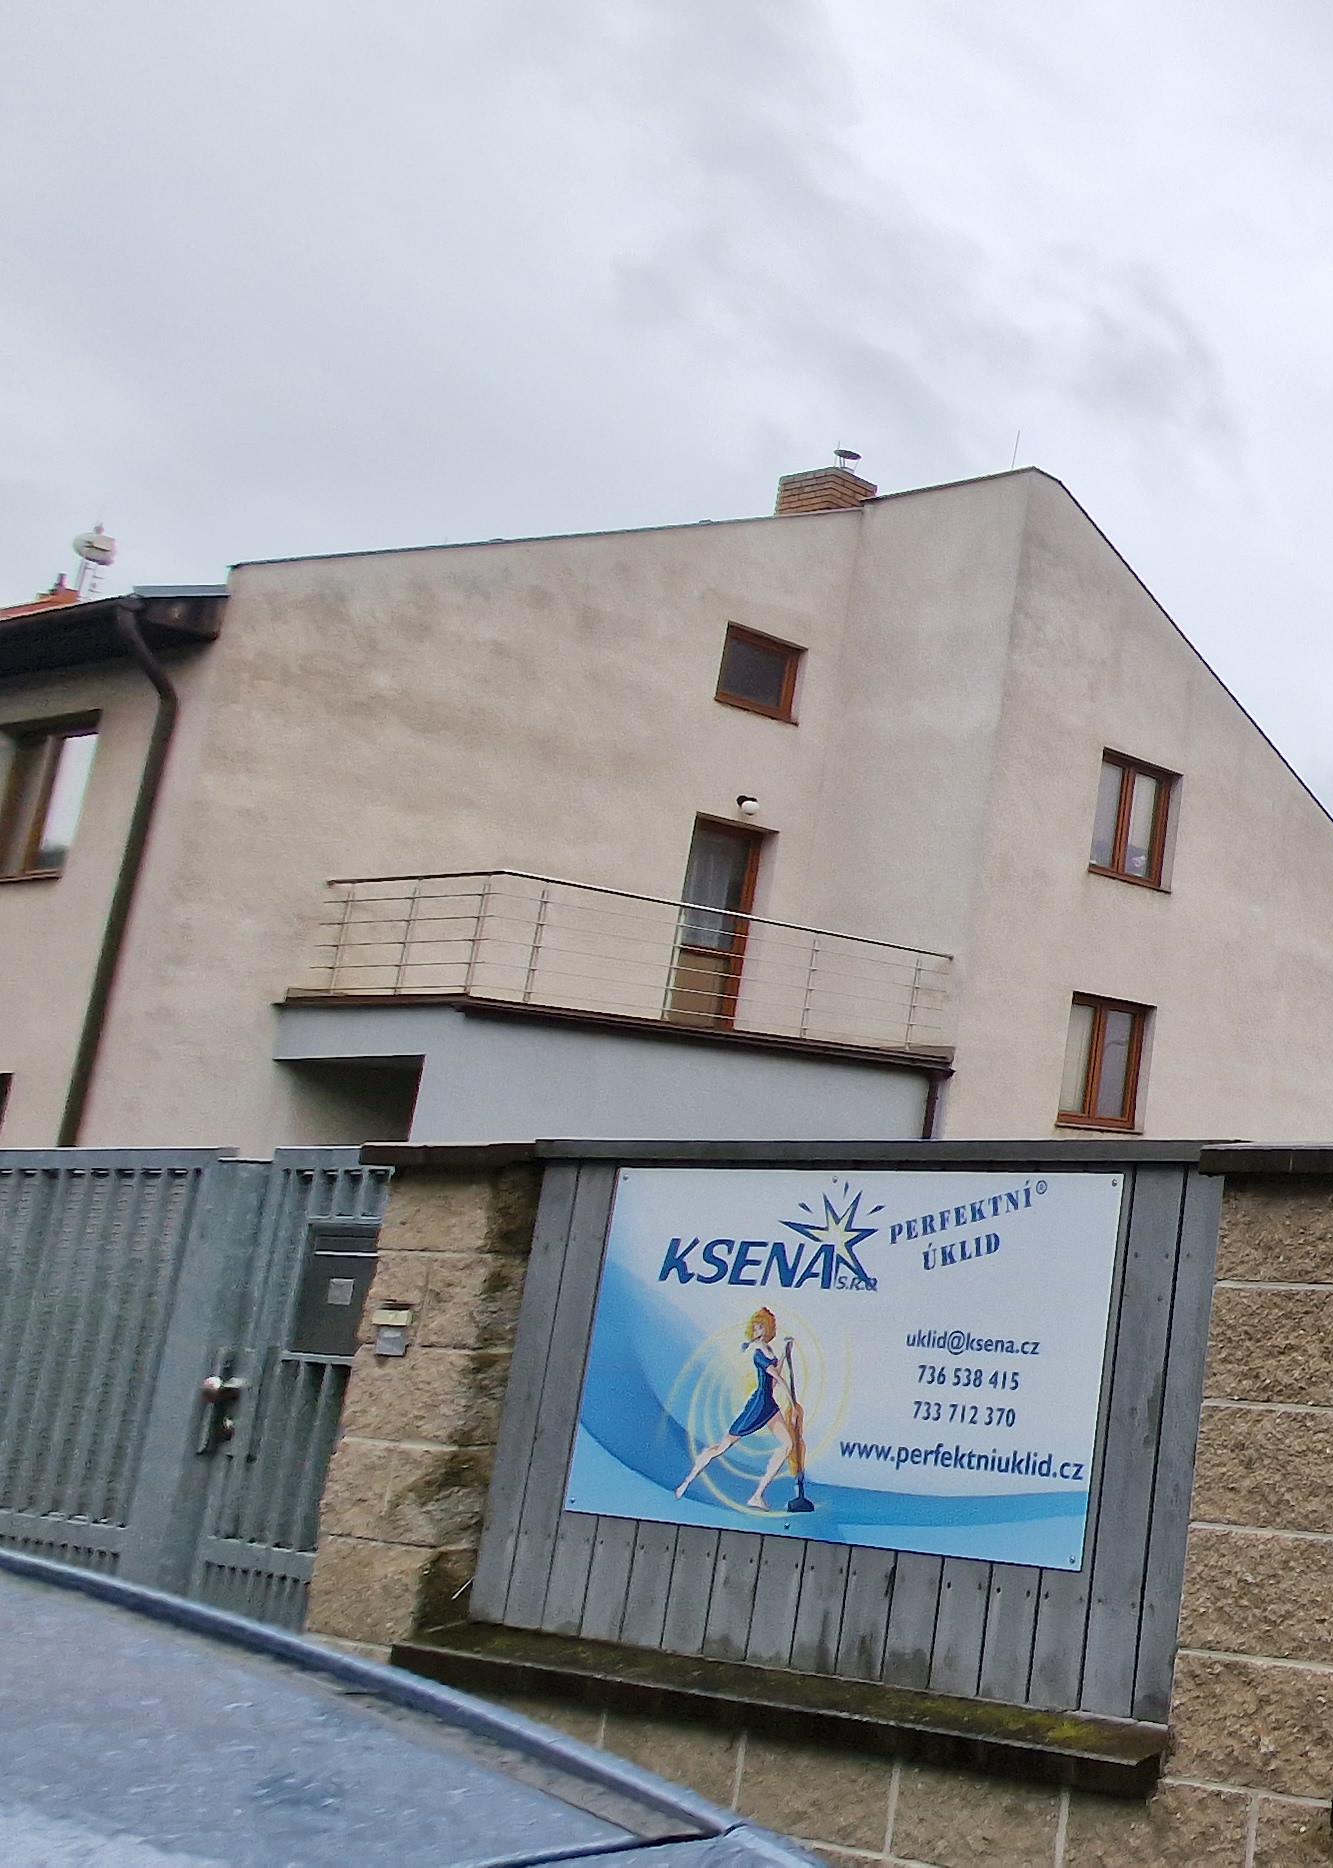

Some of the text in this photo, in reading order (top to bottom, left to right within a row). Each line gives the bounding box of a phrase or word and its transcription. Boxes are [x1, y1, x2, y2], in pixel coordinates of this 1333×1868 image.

[658, 1237, 836, 1290] KSENA
[922, 1231, 1001, 1270] ÚKLID
[906, 1329, 1040, 1355] uklid@ksena.cz
[918, 1364, 1019, 1390] 736 538 415
[913, 1401, 1015, 1428] 733 712 370
[840, 1440, 1085, 1480] www.perfektniuklid.cz
